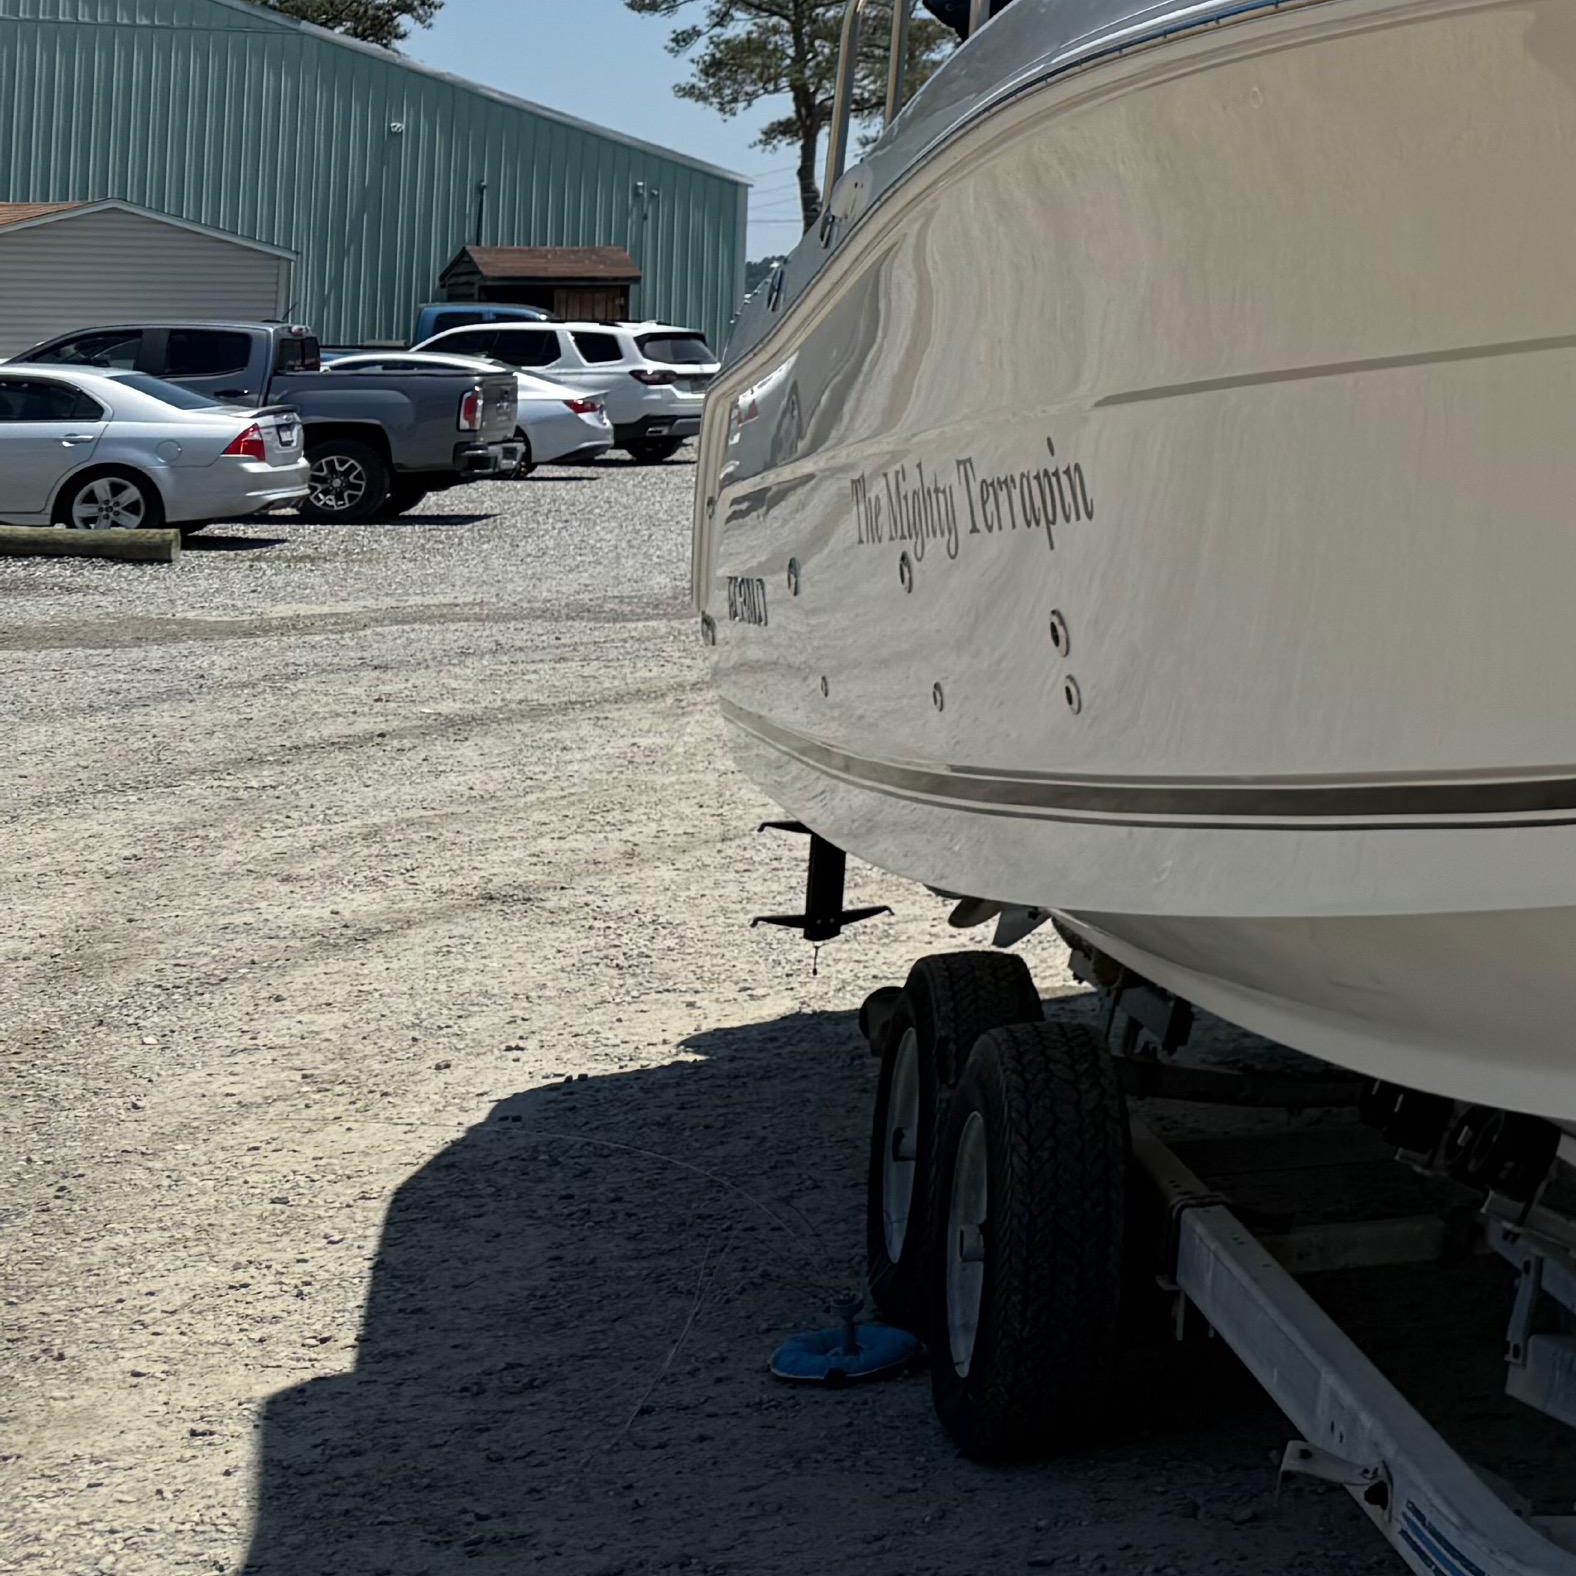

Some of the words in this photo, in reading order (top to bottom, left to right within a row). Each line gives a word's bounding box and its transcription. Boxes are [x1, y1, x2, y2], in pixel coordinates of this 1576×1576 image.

[850, 471, 882, 545] The
[882, 458, 959, 562] Mighty
[955, 436, 1094, 551] Terrapin
